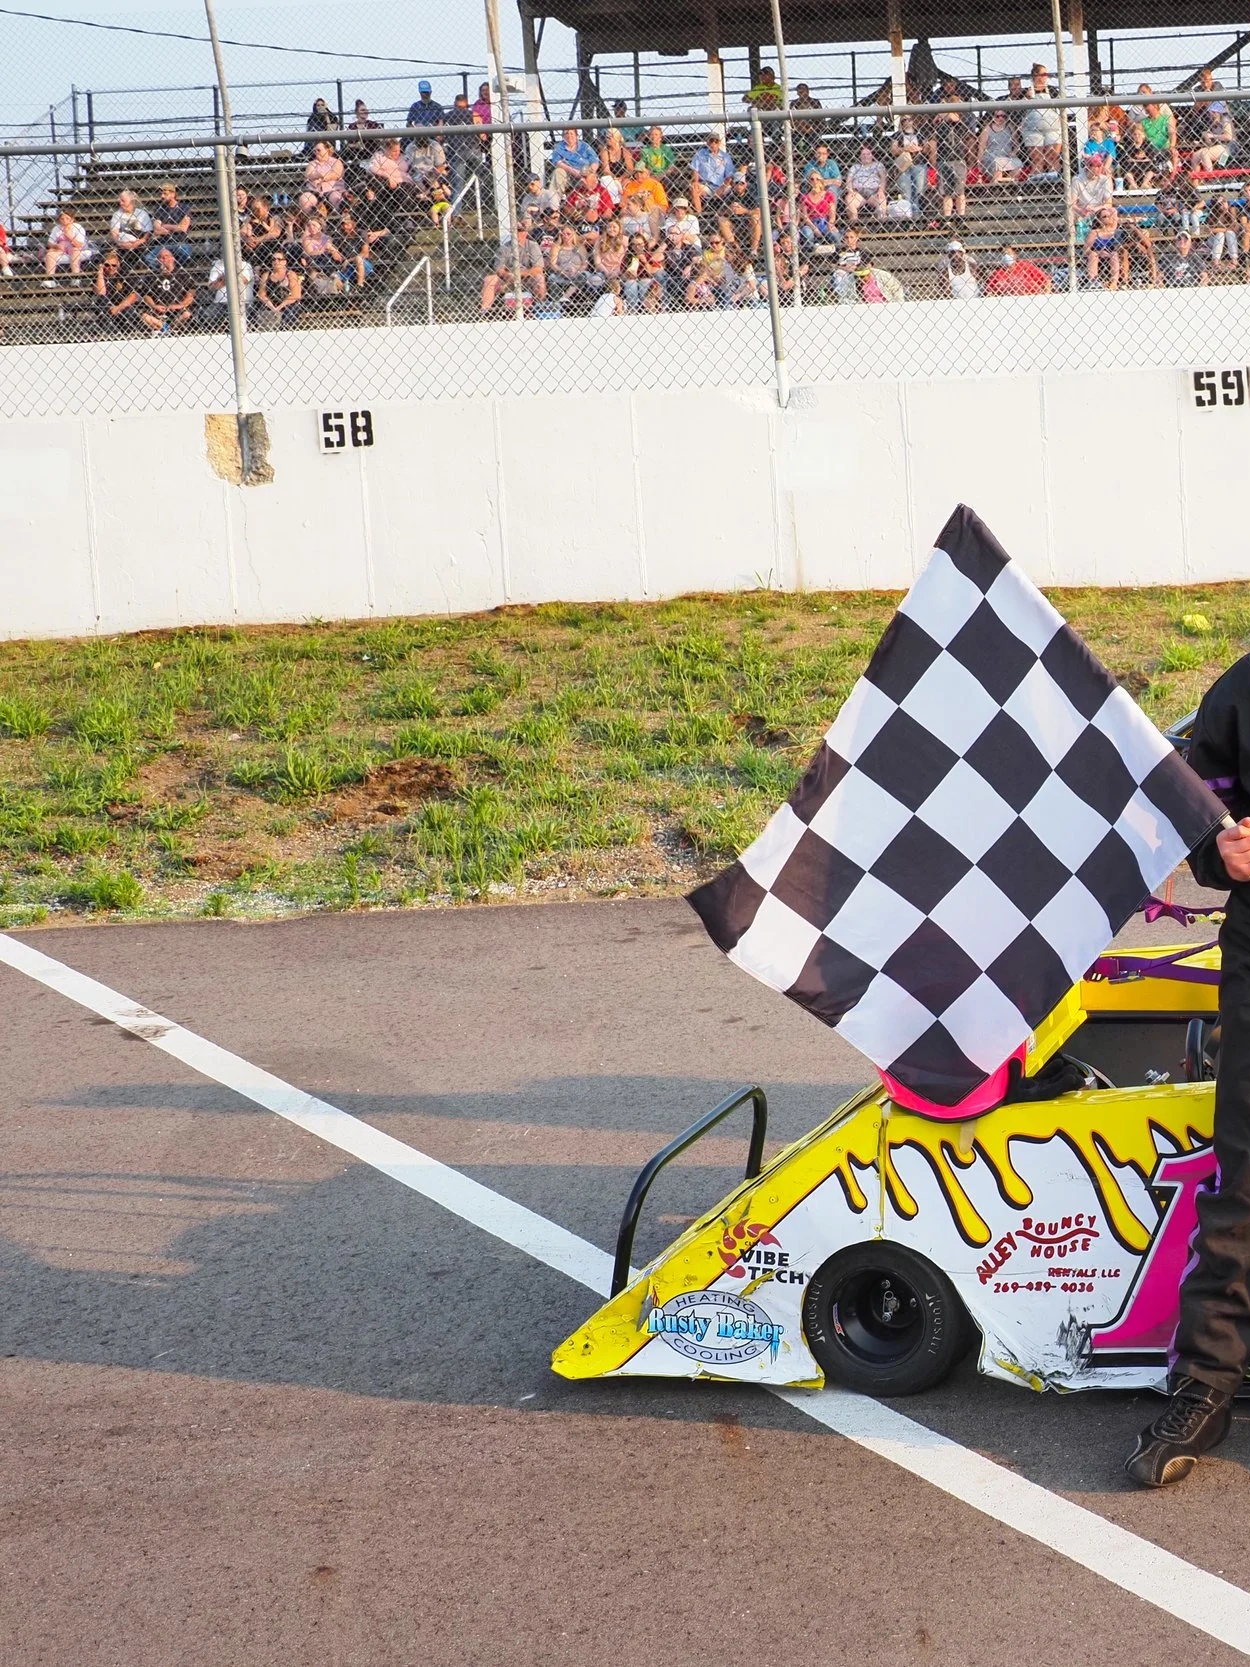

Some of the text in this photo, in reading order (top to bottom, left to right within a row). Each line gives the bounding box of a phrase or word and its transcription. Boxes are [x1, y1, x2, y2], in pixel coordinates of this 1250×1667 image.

[1193, 370, 1245, 407] 59
[322, 410, 374, 448] 58
[1022, 1213, 1098, 1236] BOUNCY
[739, 1248, 790, 1267] VIBE
[975, 1231, 1018, 1286] ALLEY
[1030, 1238, 1091, 1259] HOUSE
[675, 1293, 755, 1313] HEATING
[648, 1306, 784, 1342] Rusty Baker
[673, 1337, 759, 1362] COOLING
